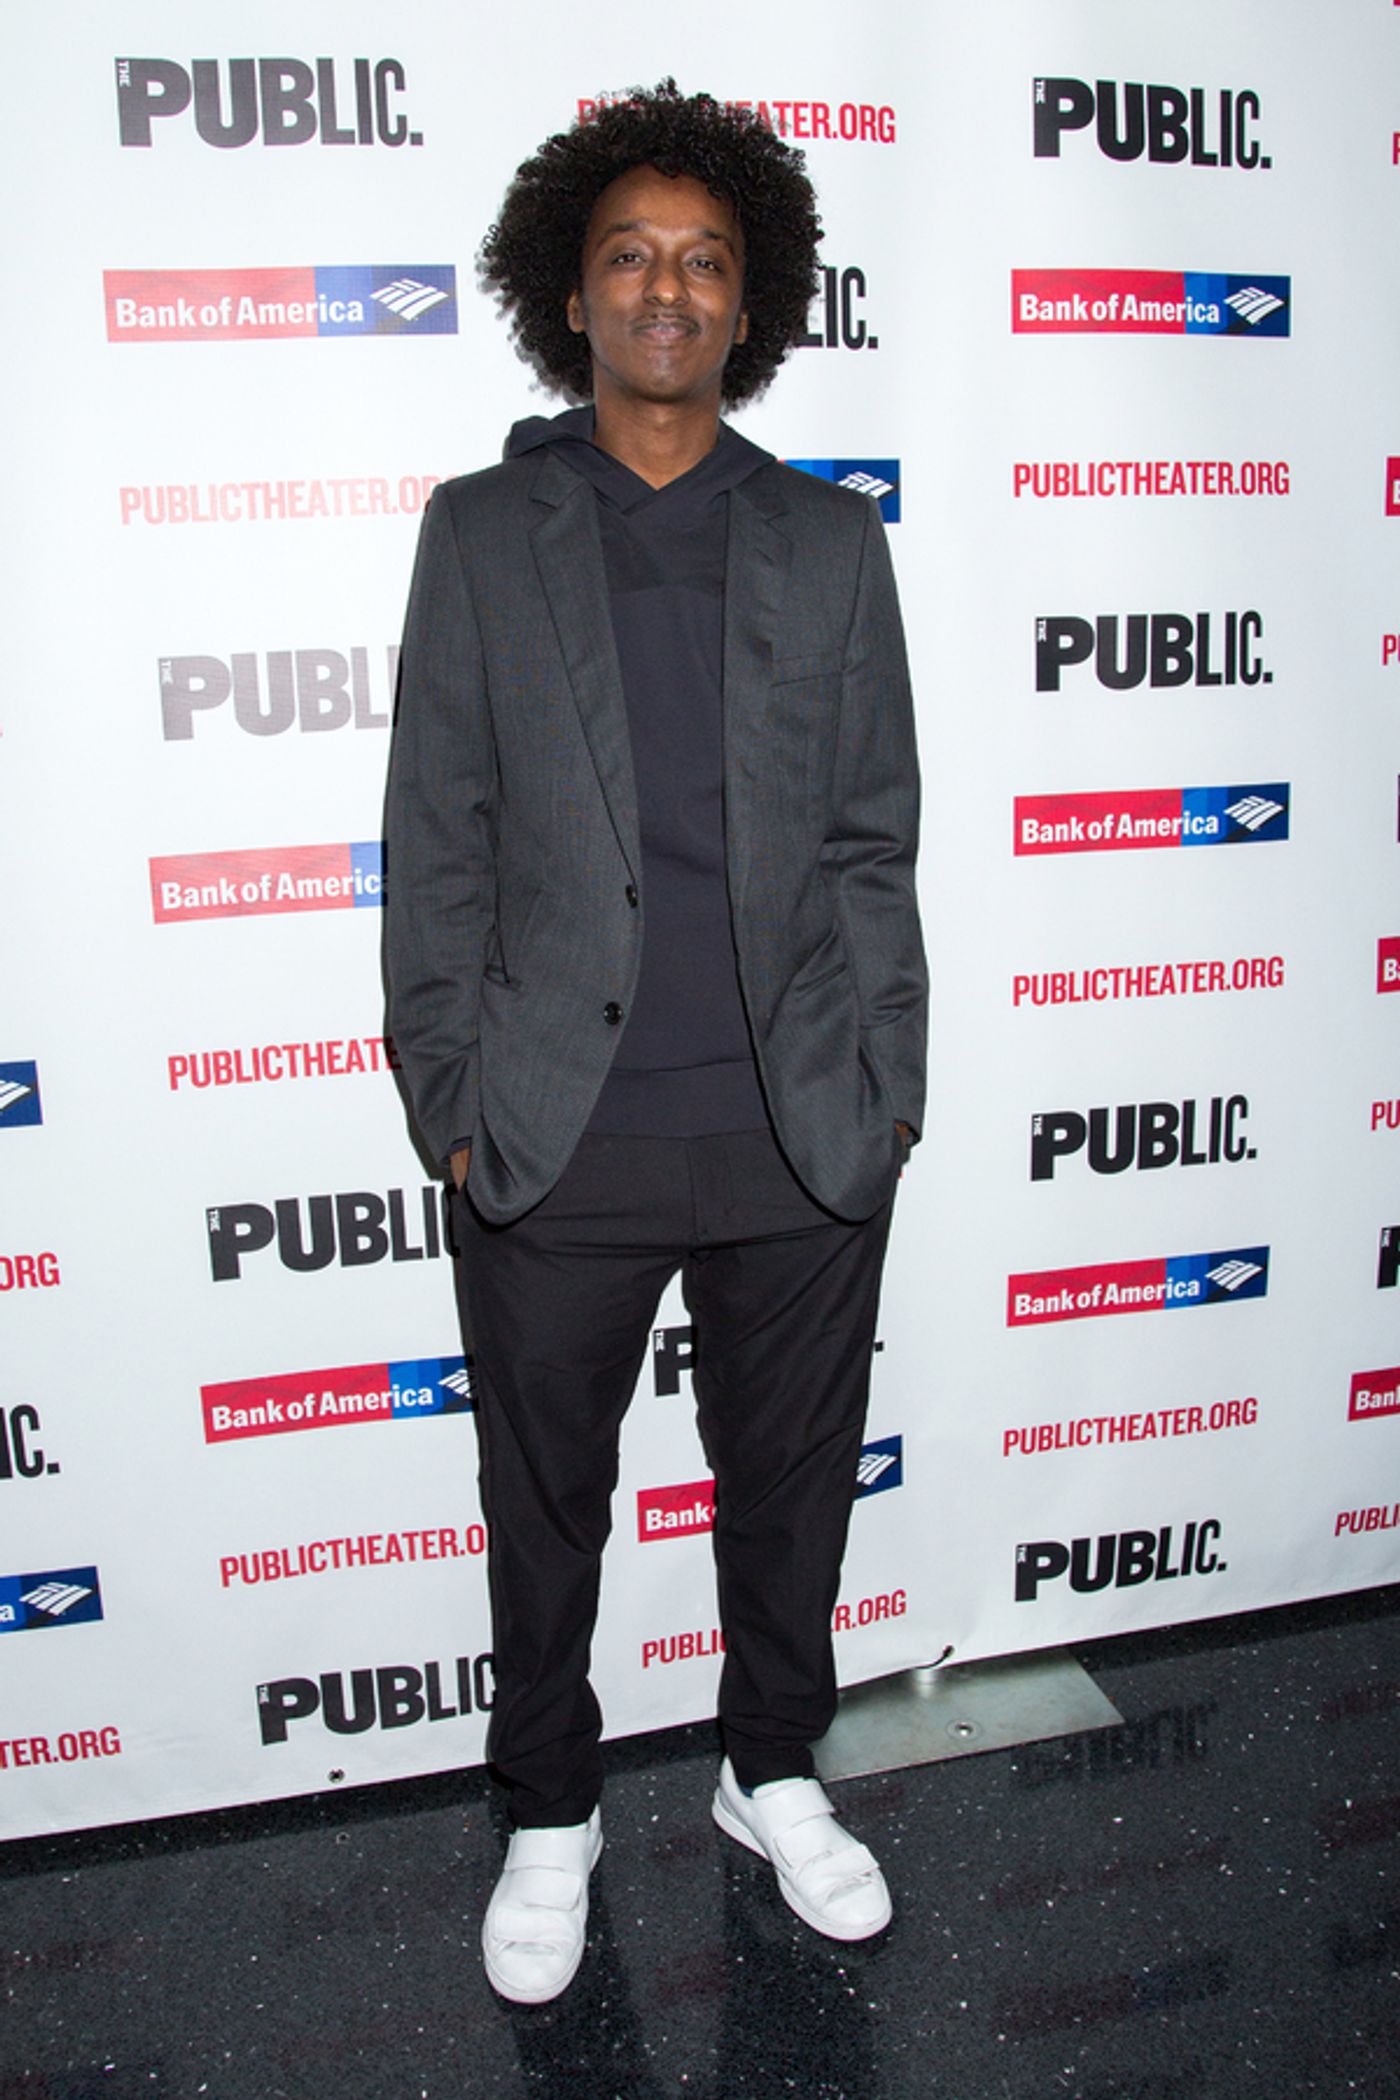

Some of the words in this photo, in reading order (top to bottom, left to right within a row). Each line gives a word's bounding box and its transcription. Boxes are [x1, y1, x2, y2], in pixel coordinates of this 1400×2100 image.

[118, 60, 131, 88] THE
[115, 57, 424, 149] PUBLIC.
[1033, 77, 1272, 169] PUBLIC.
[115, 297, 197, 328] Bank
[199, 296, 233, 327] of
[235, 294, 364, 325] America
[1019, 293, 1089, 321] Bank
[1091, 293, 1120, 321] of
[1120, 294, 1219, 324] America
[1013, 461, 1290, 498] PUBLICTHEATER.ORG
[1034, 610, 1273, 692] PUBLIC.
[1021, 816, 1087, 844] Bank
[1086, 813, 1114, 840] of
[1114, 810, 1219, 839] America
[161, 877, 239, 910] Bank
[240, 874, 272, 903] of
[275, 868, 383, 900] Americ
[1012, 956, 1285, 1007] PUBLICTHEATER.ORG
[1031, 1094, 1257, 1181] PUBLIC.
[1013, 1289, 1076, 1317] Bank
[1076, 1284, 1103, 1308] of
[1102, 1277, 1200, 1305] America
[211, 1399, 284, 1432] Bank
[286, 1392, 316, 1419] of
[318, 1384, 433, 1416] America
[1003, 1397, 1258, 1457] PUBLICTHEATER.ORG
[645, 1505, 711, 1532] Bank
[1014, 1519, 1228, 1602] PUBLIC.
[830, 1588, 907, 1632] R.ORG
